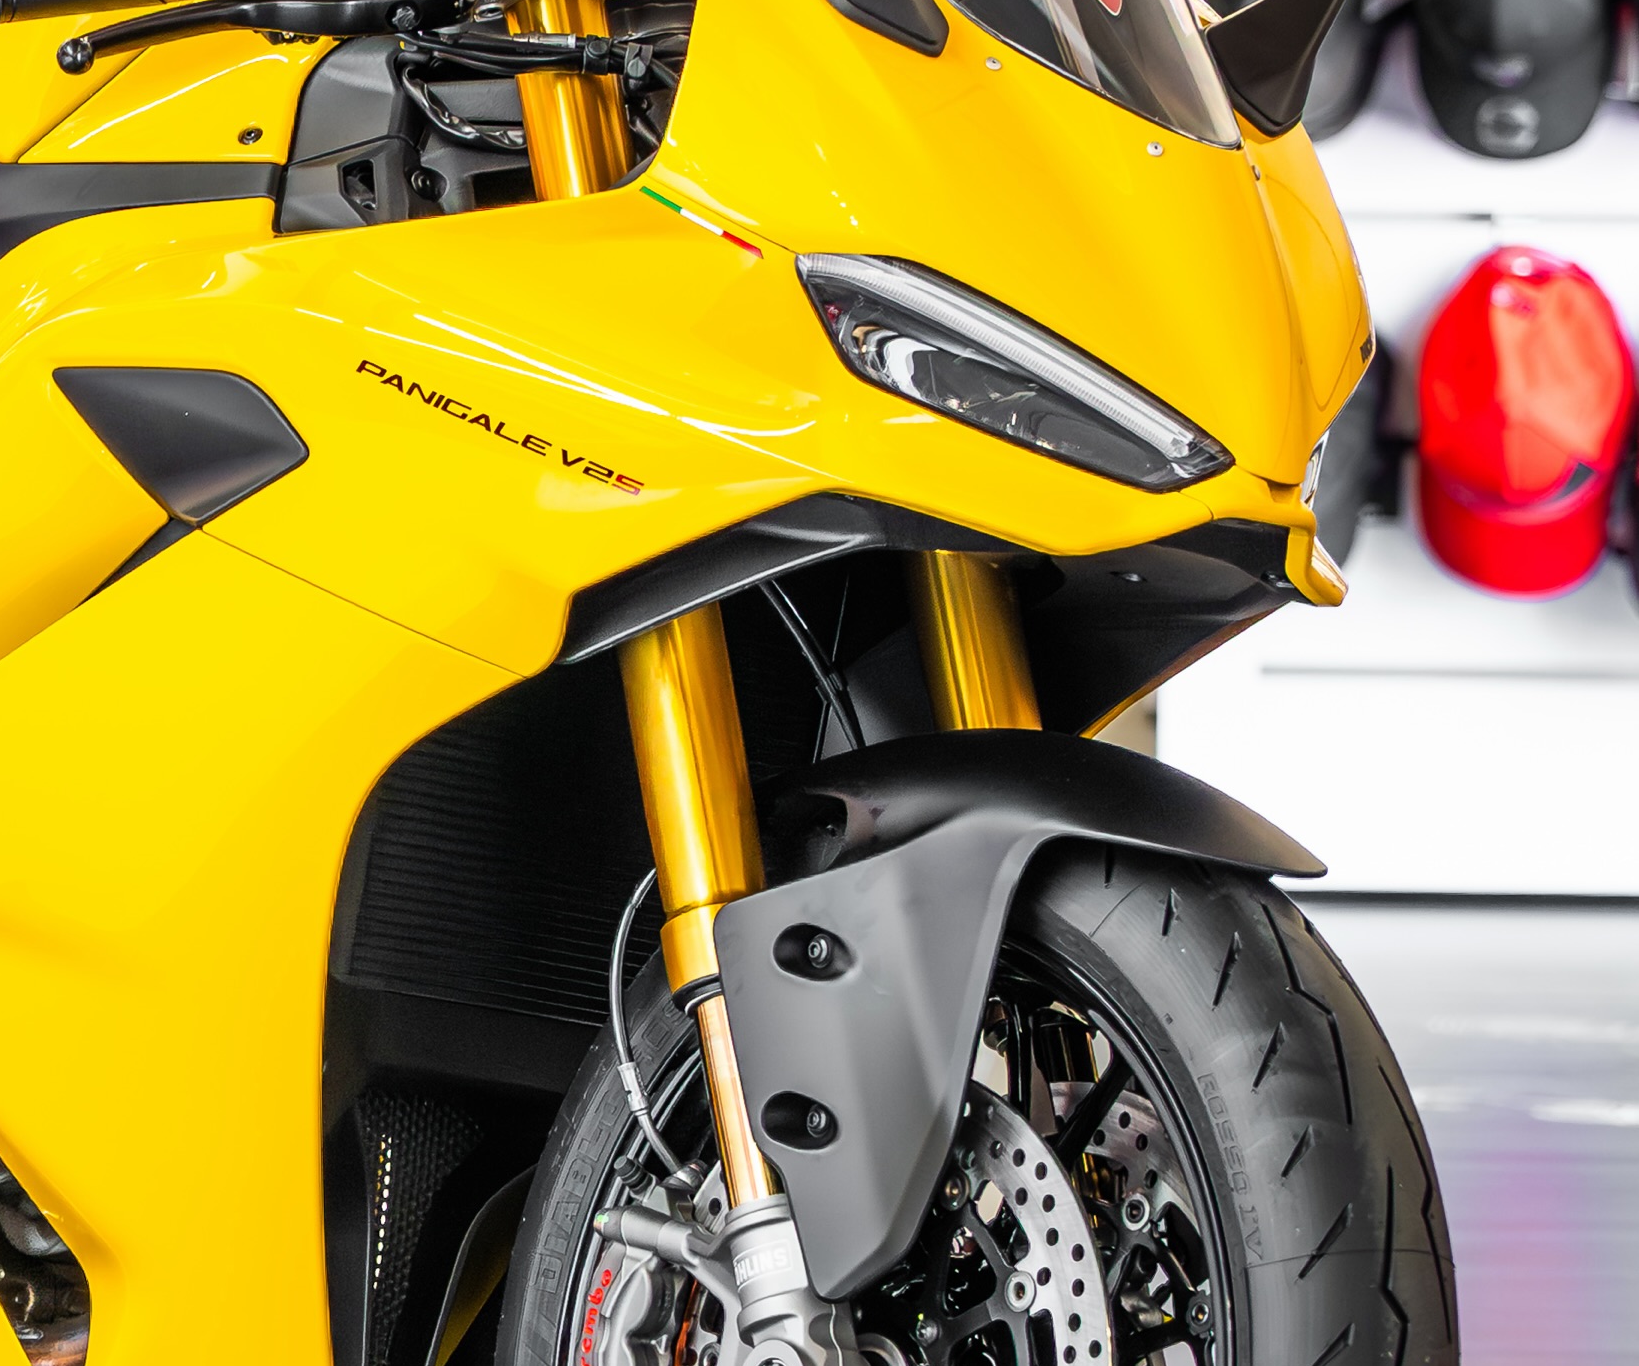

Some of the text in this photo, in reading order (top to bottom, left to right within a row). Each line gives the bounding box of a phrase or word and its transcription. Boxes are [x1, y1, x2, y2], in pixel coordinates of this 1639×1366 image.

[355, 359, 645, 496] PANIGALE V2S
[534, 1097, 626, 1294] DIABLO
[1197, 1072, 1251, 1196] ROSSO
[733, 1247, 789, 1286] HLINS
